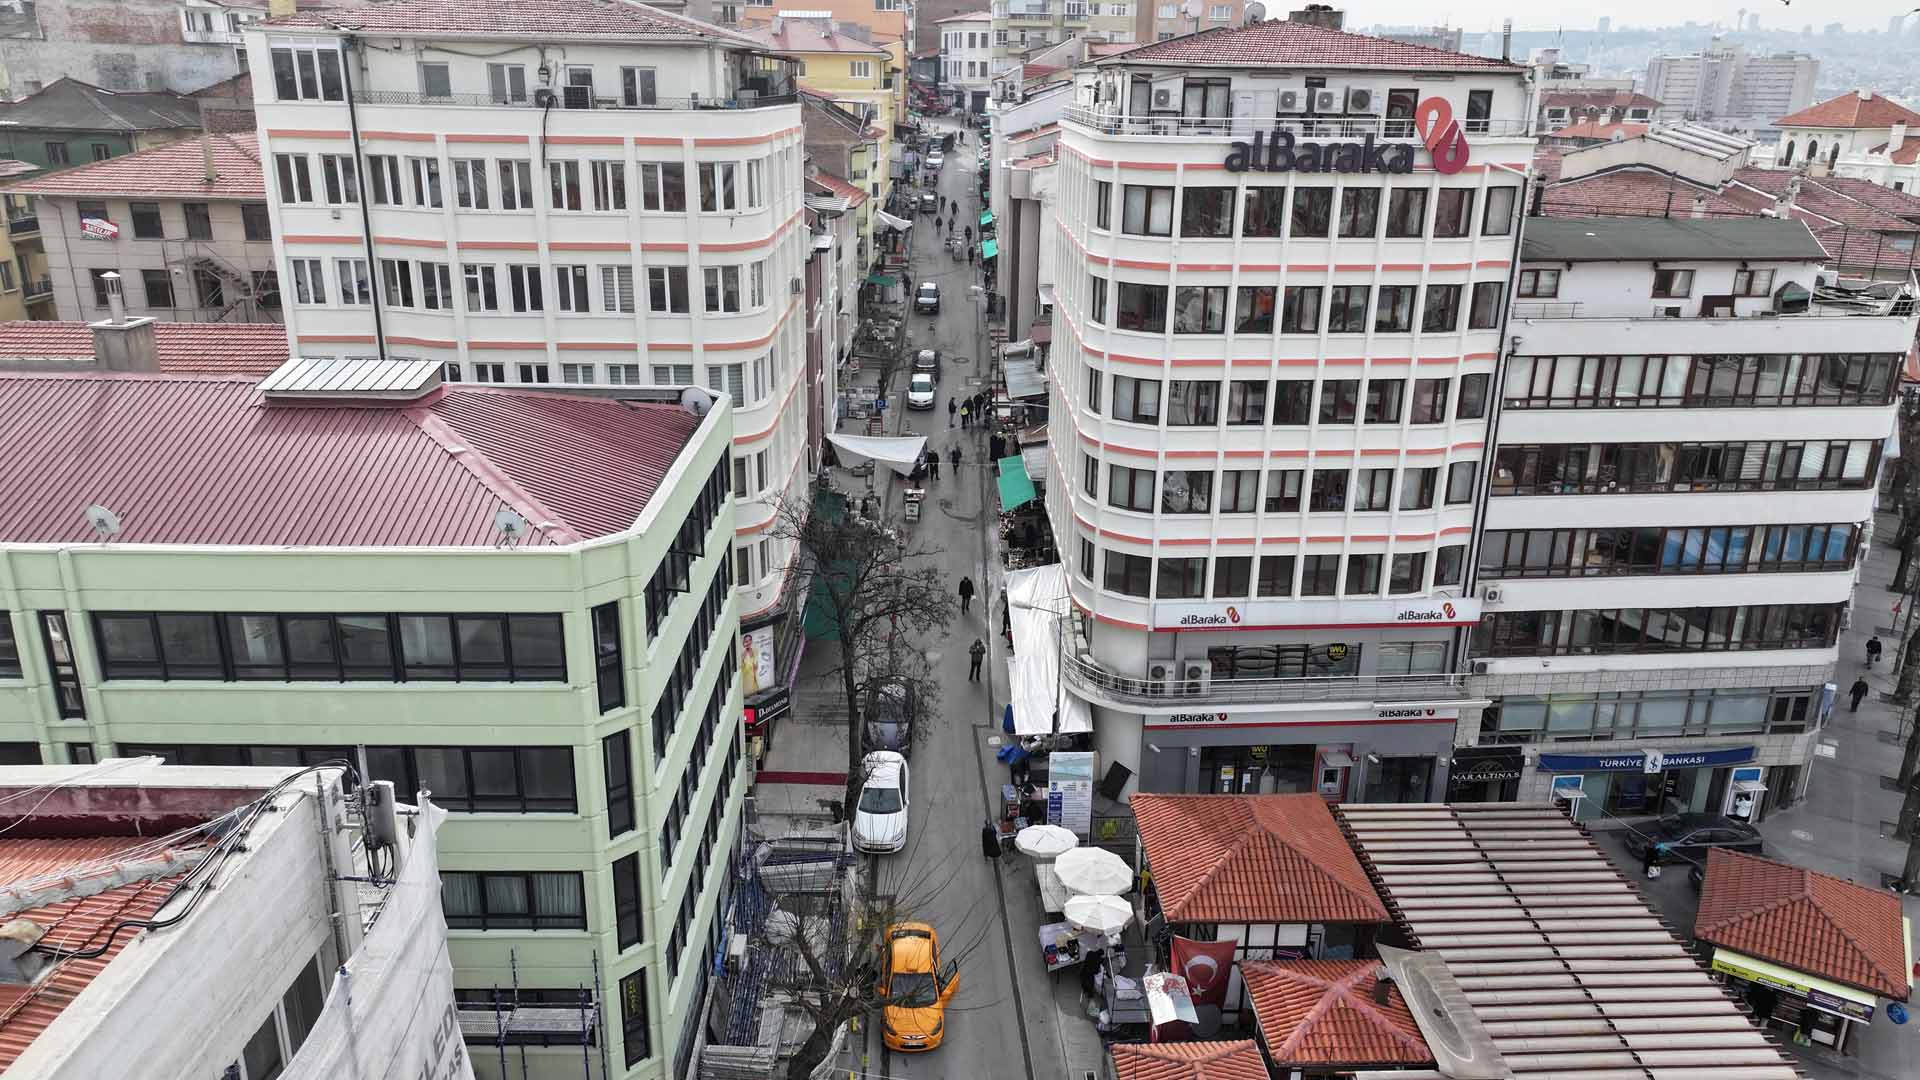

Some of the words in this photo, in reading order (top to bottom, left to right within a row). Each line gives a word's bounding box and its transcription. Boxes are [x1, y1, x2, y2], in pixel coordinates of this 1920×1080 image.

[1224, 130, 1415, 174] alBaraka
[1180, 614, 1227, 625] alBaraka
[1398, 610, 1443, 620] alBaraka
[1169, 713, 1215, 723] alBaraka
[1599, 757, 1643, 769] TÜRKİYE
[1662, 756, 1705, 766] BANKASI
